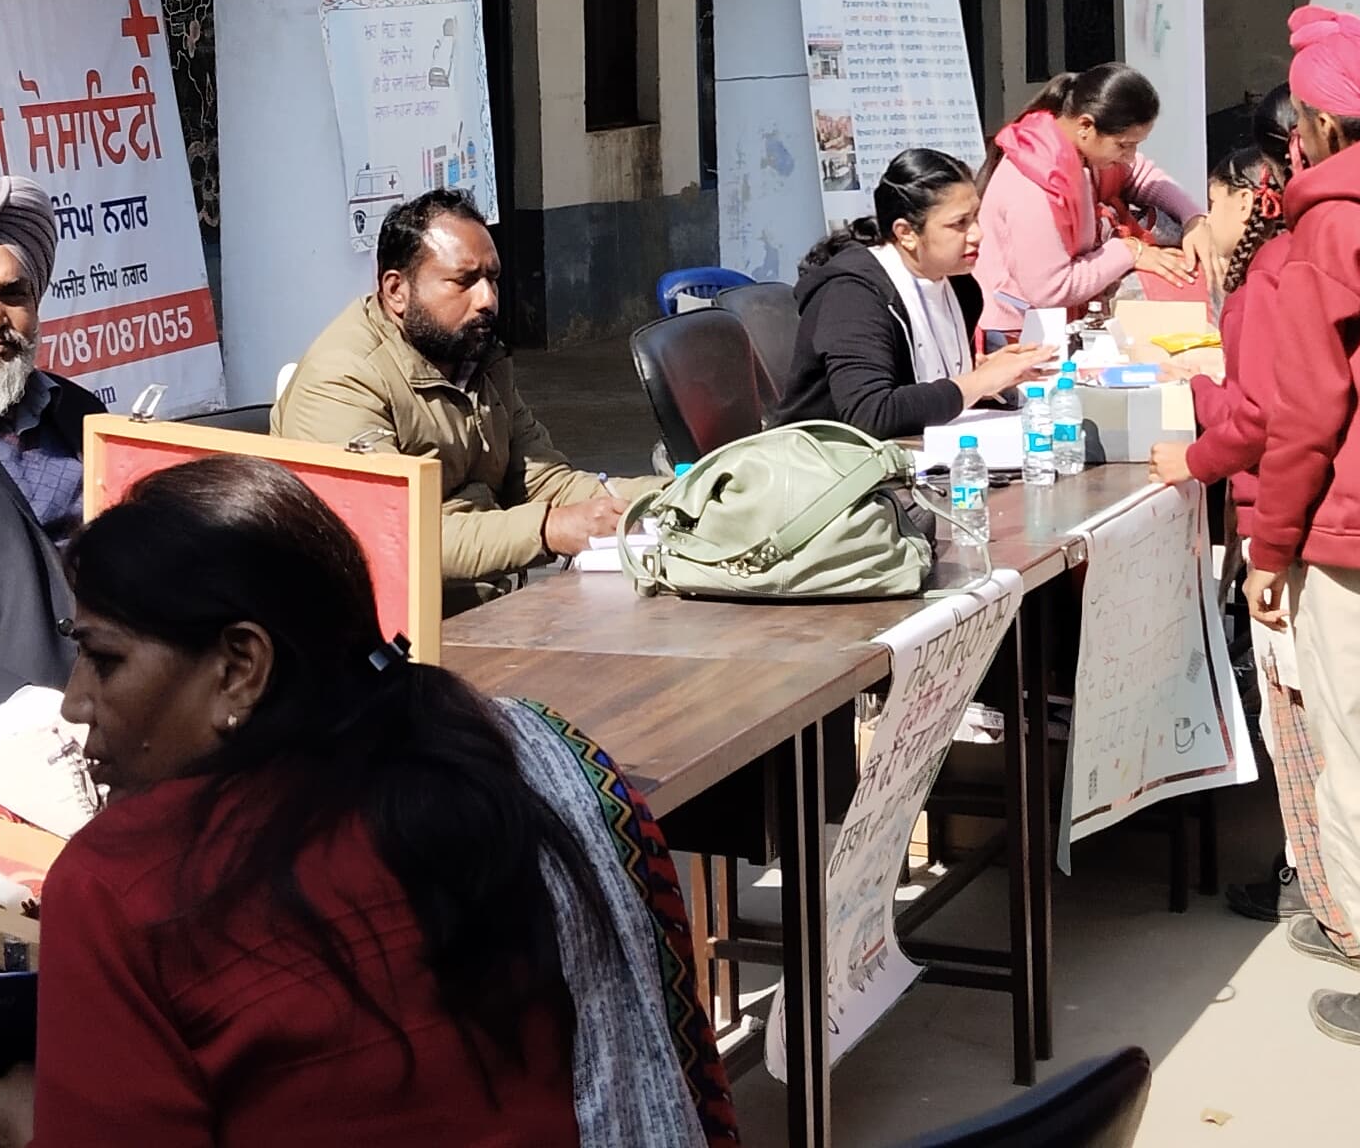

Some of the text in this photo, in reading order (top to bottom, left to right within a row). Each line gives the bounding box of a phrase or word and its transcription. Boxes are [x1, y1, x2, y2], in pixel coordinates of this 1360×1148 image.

[18, 64, 163, 174] ਸੋਸਾਇਟੀ
[100, 194, 150, 234] ਨਗਰ
[90, 262, 119, 294] ਸਿੰਘ
[121, 262, 149, 288] ਨਗਰ
[41, 304, 193, 370] 7087087055
